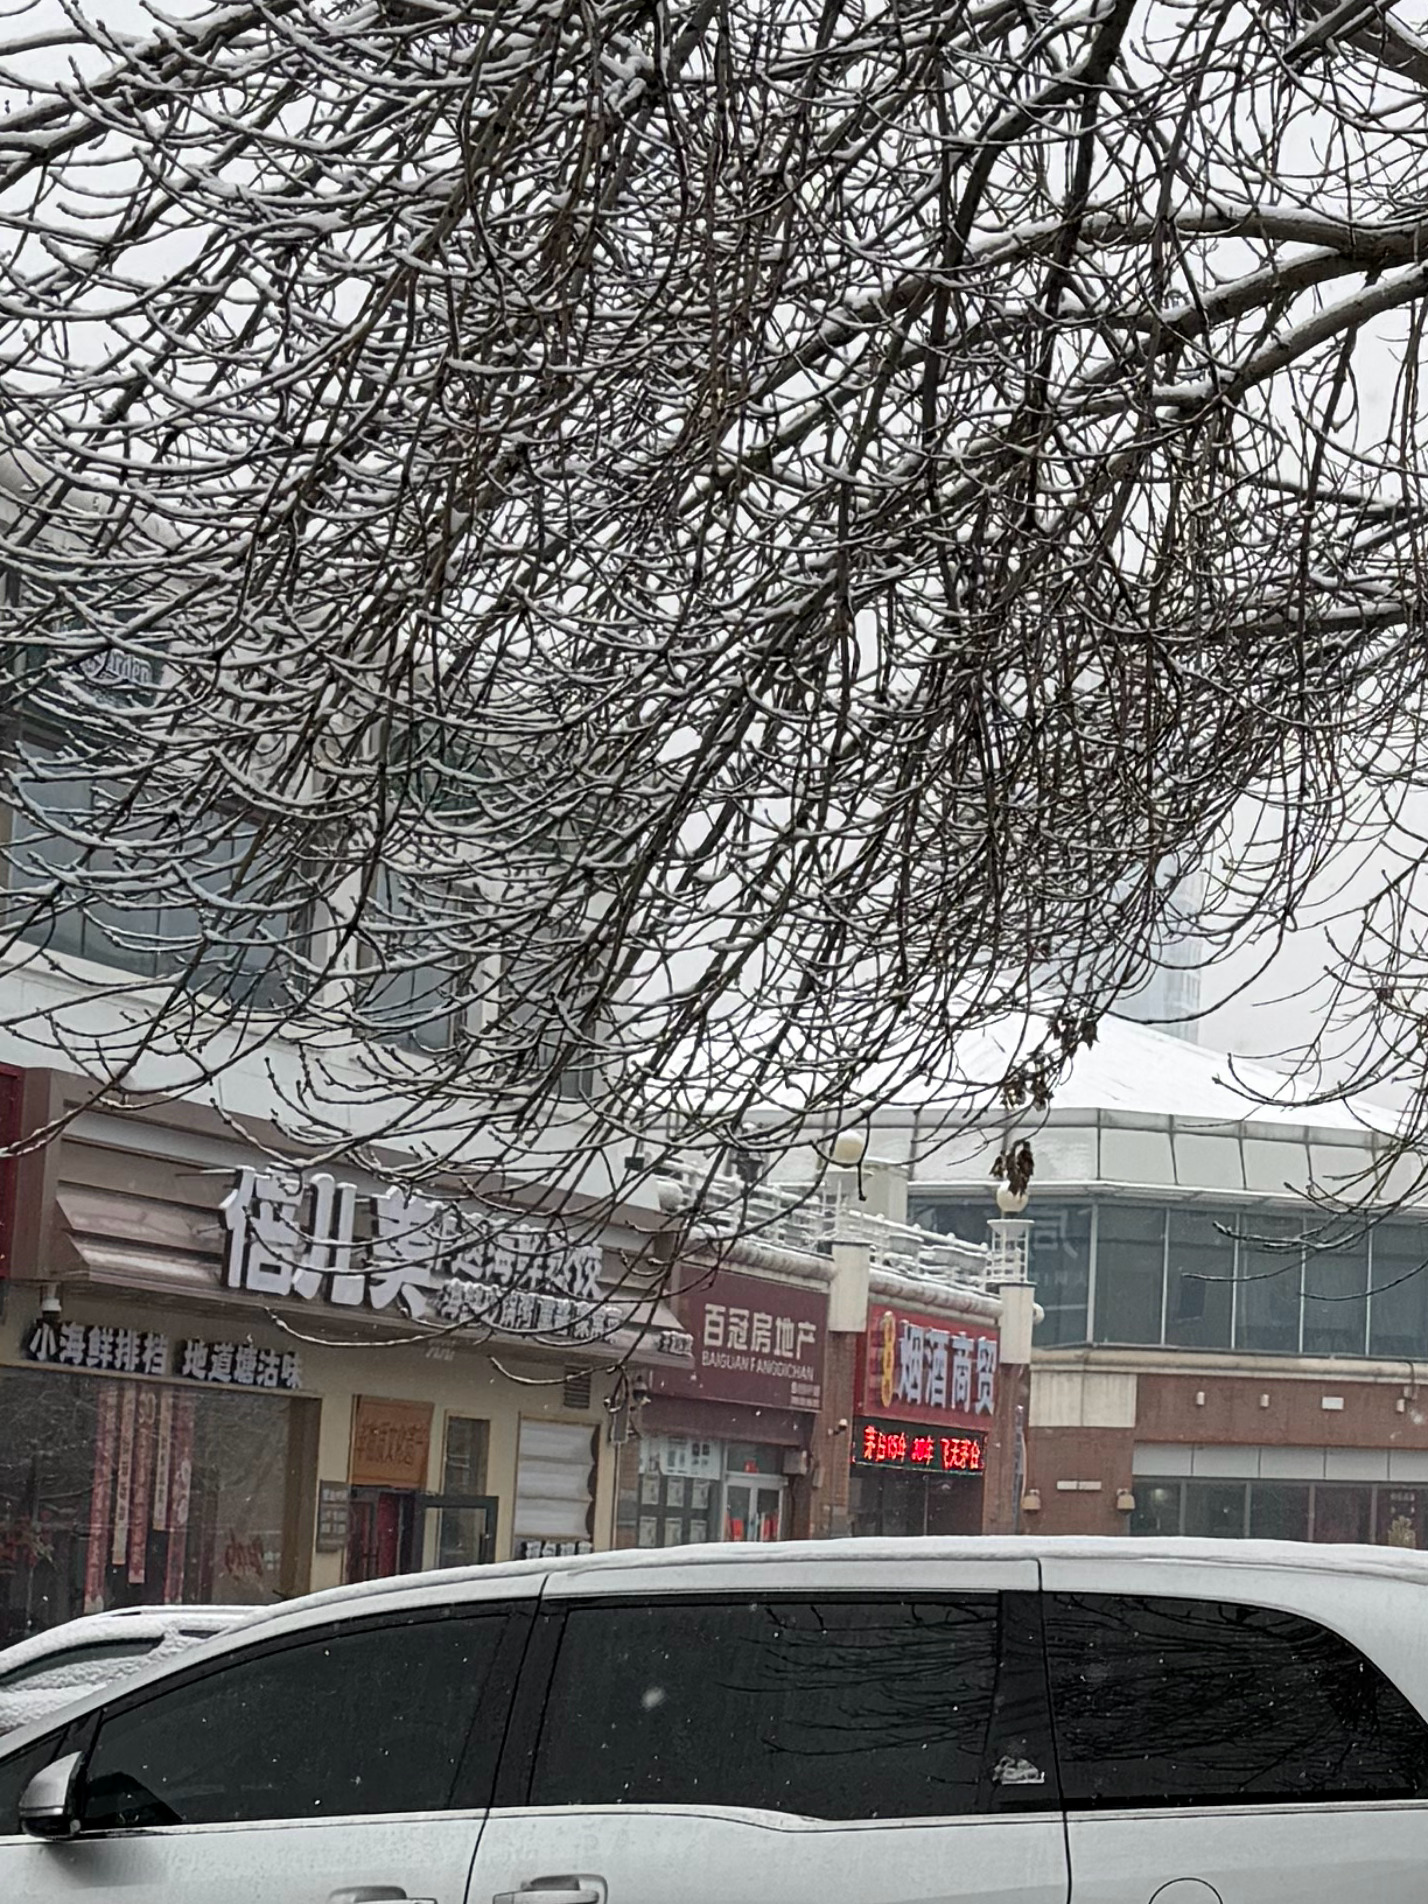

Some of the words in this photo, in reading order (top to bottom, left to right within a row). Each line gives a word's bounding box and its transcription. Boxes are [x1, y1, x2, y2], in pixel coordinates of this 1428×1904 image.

[219, 1164, 436, 1318] 倍儿美
[30, 1322, 169, 1375] 小海鲜排档
[183, 1338, 303, 1389] 地道塘沽味
[704, 1303, 816, 1360] 百冠房地产
[894, 1319, 997, 1415] 烟酒商贸
